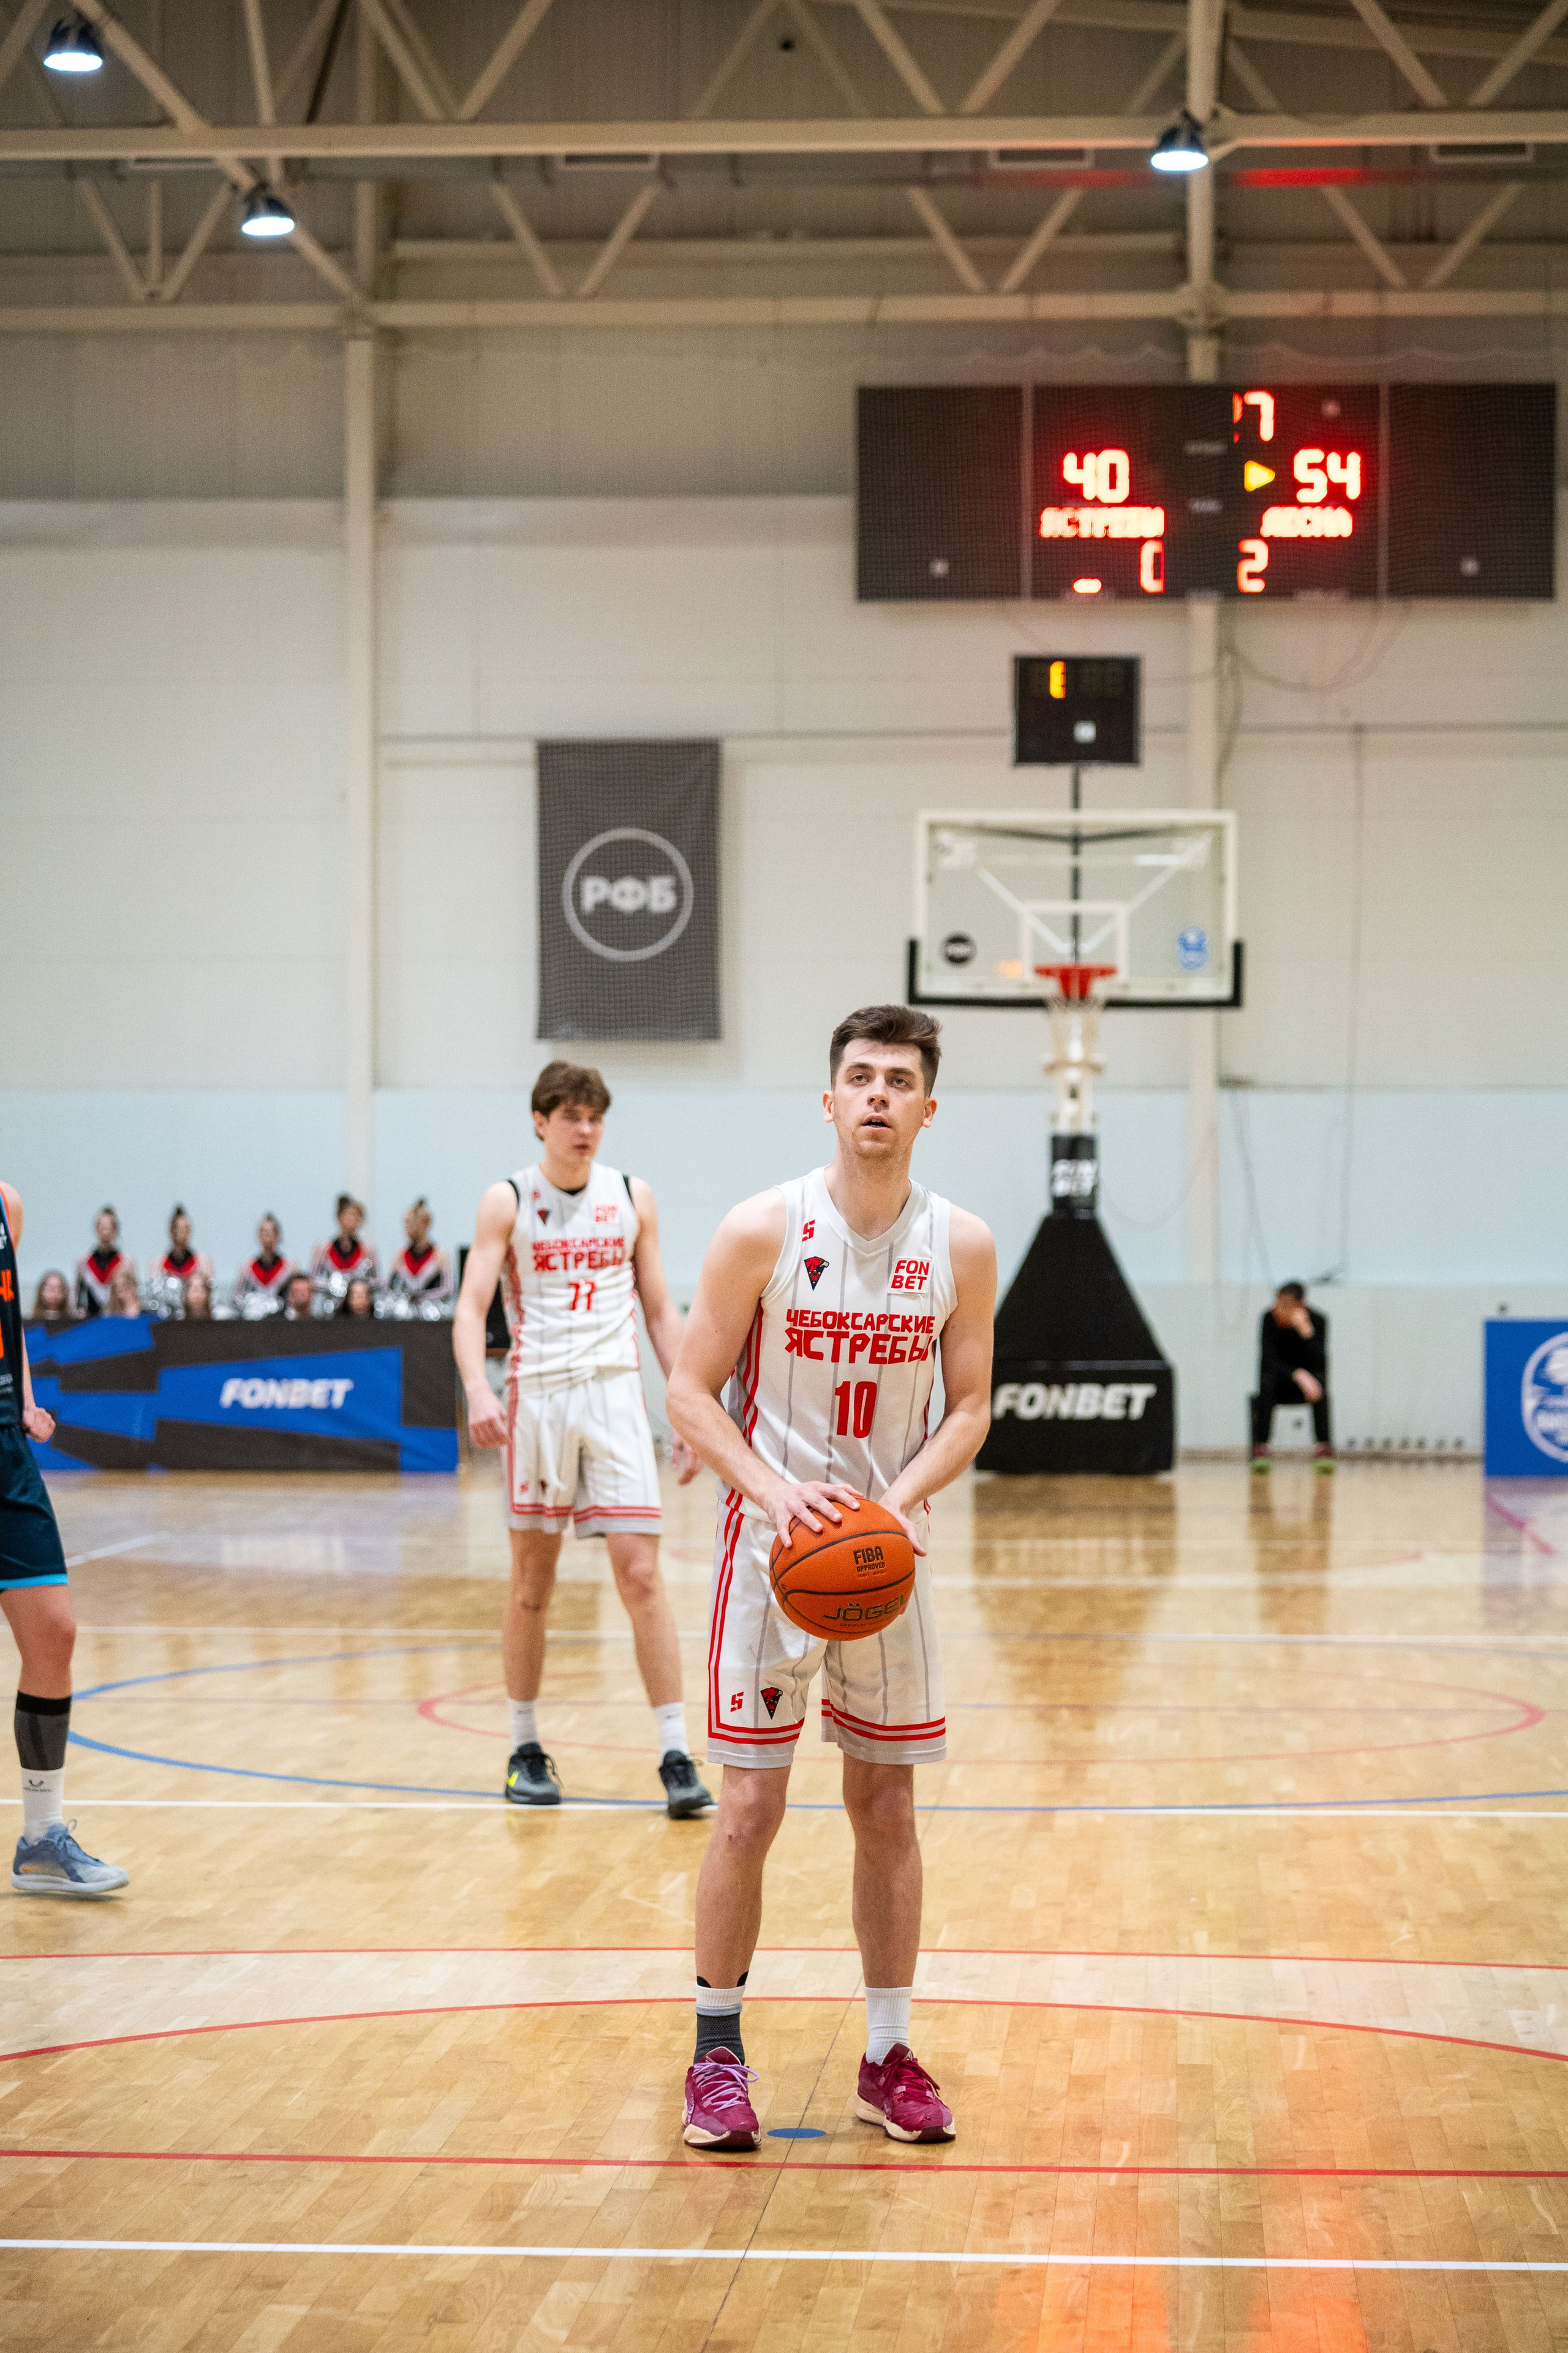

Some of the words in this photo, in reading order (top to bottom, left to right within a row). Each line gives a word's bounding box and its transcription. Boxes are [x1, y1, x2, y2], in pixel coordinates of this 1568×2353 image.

[1063, 448, 1130, 504] 40
[1294, 448, 1362, 503] 54
[1237, 538, 1269, 593] 2
[581, 874, 677, 914] РФБ
[891, 1275, 927, 1290] BET
[894, 1260, 930, 1275] FON
[568, 1280, 597, 1312] 77
[786, 1309, 935, 1334] ЧЕБОКСАРСКИЕ
[785, 1327, 933, 1365] ЯСТРЕБЫ
[219, 1378, 355, 1409] FONBET
[835, 1381, 877, 1438] 10
[991, 1382, 1158, 1421] FONBET
[853, 1546, 884, 1565] FIBA
[856, 1562, 885, 1573] APPROVED
